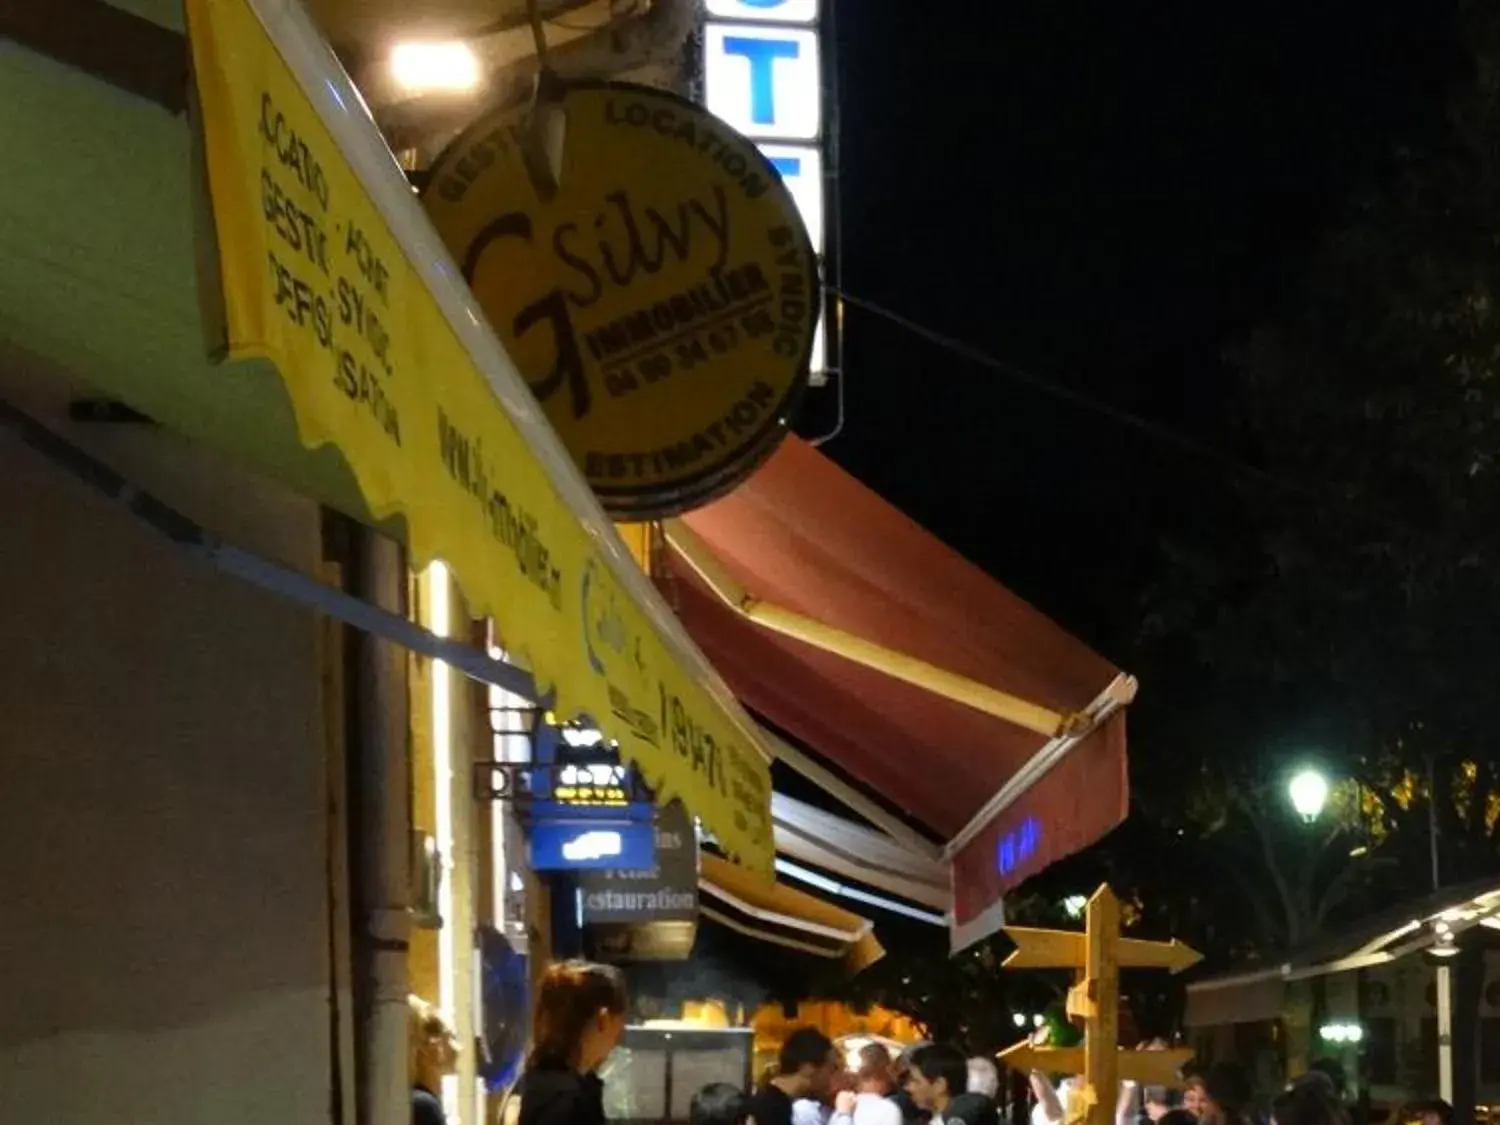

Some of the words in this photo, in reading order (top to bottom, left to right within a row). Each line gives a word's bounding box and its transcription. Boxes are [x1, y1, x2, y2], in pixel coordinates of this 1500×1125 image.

[604, 99, 770, 199] LOCATION
[766, 224, 801, 357] SYNDIC
[587, 380, 776, 478] ESTIMATION
